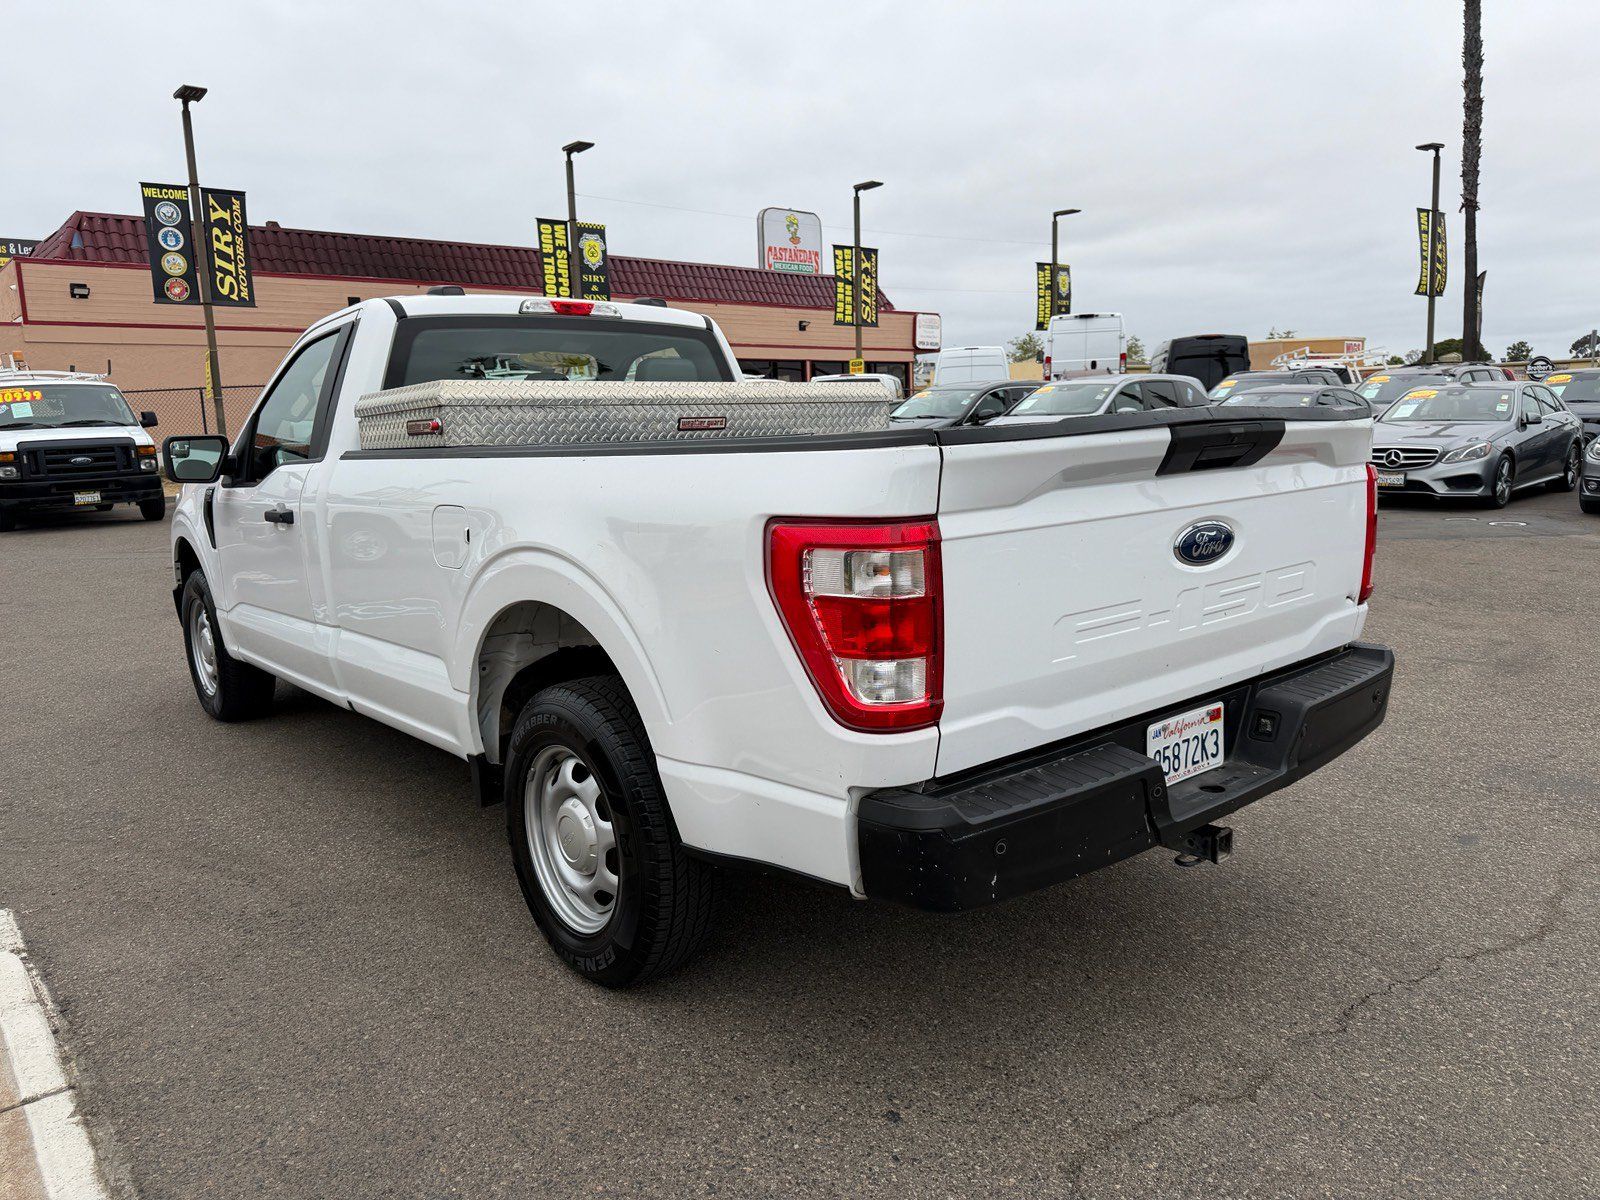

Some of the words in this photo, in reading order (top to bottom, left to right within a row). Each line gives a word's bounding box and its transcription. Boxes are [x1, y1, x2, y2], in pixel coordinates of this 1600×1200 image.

[142, 187, 188, 200] WELCOME
[554, 224, 567, 247] WE
[1420, 212, 1428, 231] WE
[208, 193, 239, 302] SIRY
[232, 196, 249, 301] MOTORS.COM
[540, 224, 554, 254] OUR
[1421, 233, 1429, 258] BUY
[543, 256, 558, 298] TROO
[556, 249, 571, 298] SUPPO
[582, 274, 606, 283] SIRY
[774, 262, 798, 271] MEXICAN
[798, 264, 814, 273] FOOD
[834, 249, 844, 279] PAY
[844, 249, 853, 281] BUY
[836, 282, 845, 321] HERE
[861, 250, 872, 323] SIRY
[845, 284, 853, 323] HERE
[681, 419, 705, 428] weather
[1192, 530, 1225, 557] Ford
[514, 713, 558, 746] GRABBER
[1162, 717, 1206, 740] California
